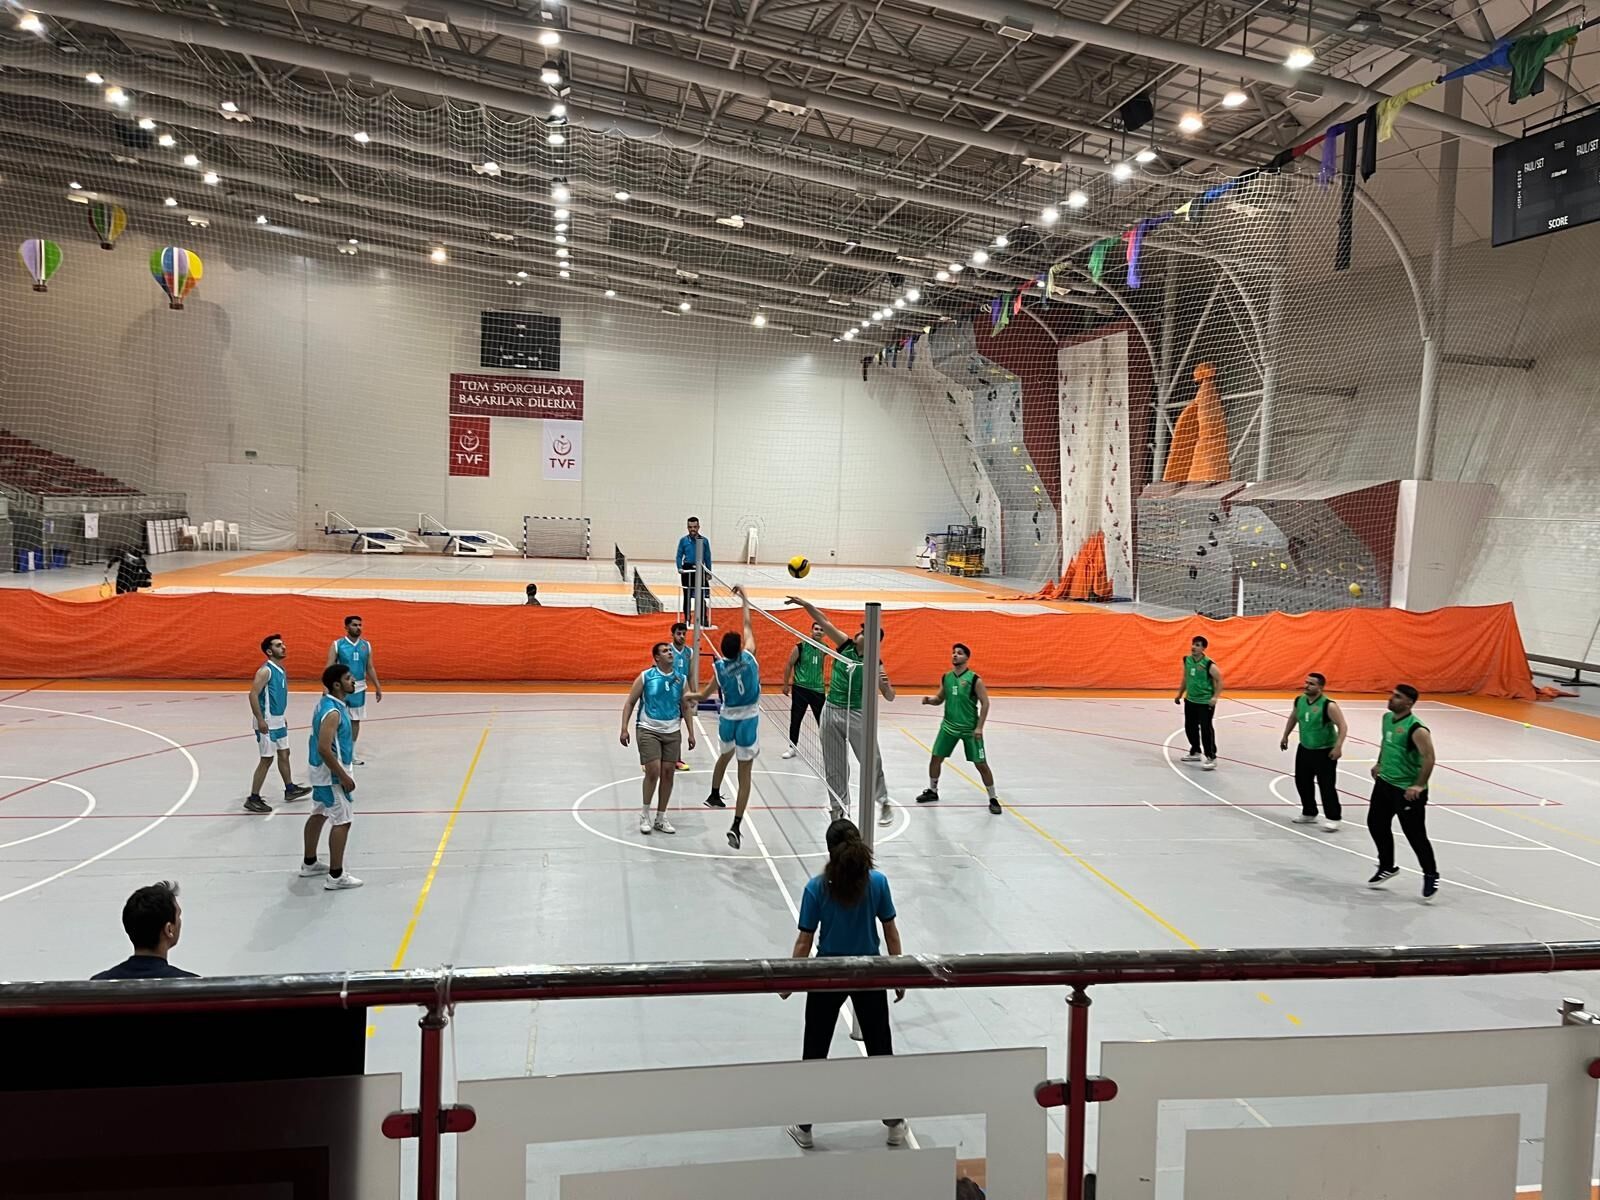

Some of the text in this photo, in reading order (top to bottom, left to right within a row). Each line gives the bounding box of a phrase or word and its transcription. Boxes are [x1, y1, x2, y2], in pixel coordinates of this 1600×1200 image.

[1548, 215, 1569, 229] SCORE
[493, 382, 574, 396] SPORCULARA
[459, 393, 577, 409] BAŞARILAR DİLERİM
[456, 453, 484, 465] TVF
[549, 458, 576, 469] TVF
